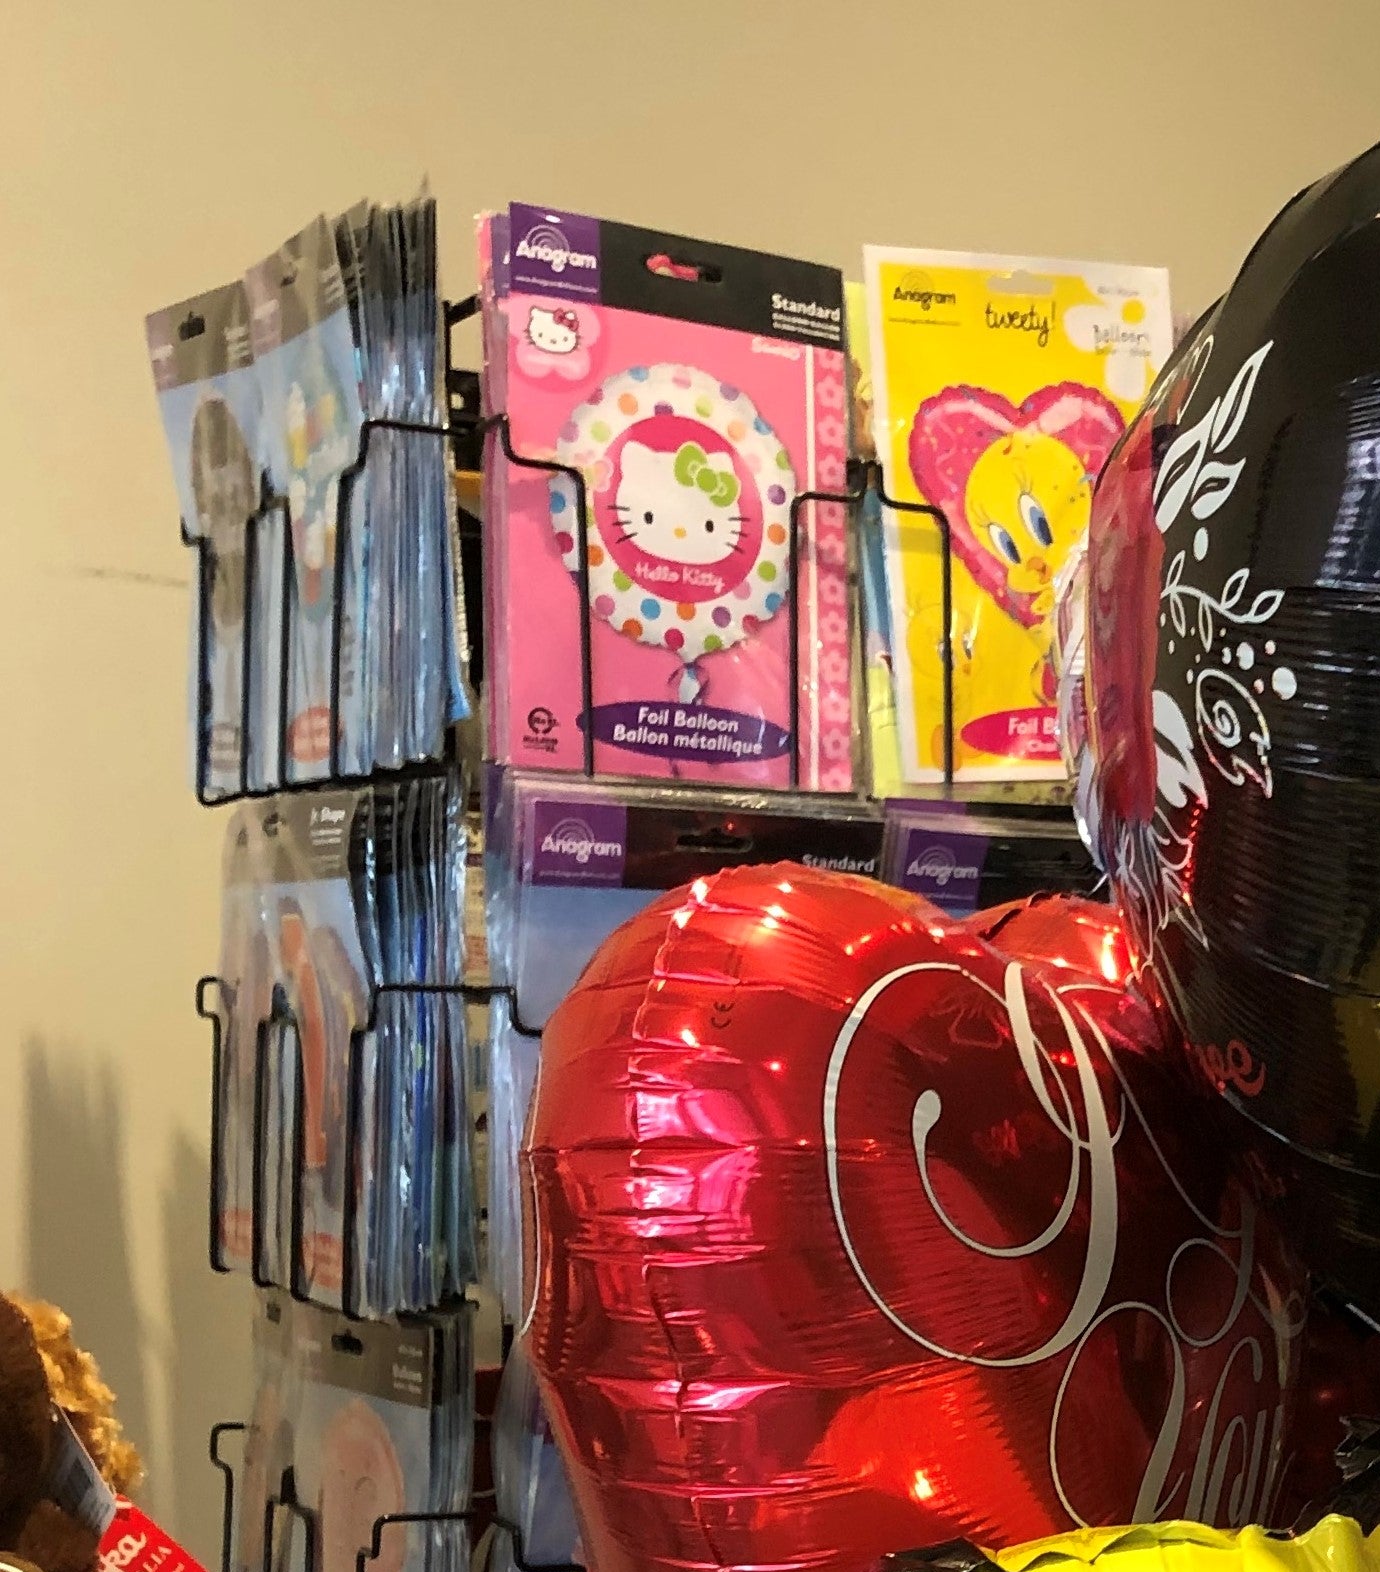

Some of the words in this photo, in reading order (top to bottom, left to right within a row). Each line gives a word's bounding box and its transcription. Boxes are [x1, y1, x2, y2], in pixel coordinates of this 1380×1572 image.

[771, 293, 841, 323] Standard
[634, 562, 680, 584] Hello
[637, 706, 670, 727] Foil
[673, 708, 739, 733] Balloon
[1007, 716, 1039, 735] Foil
[612, 725, 669, 747] Ballon
[540, 835, 623, 864] Anagram
[906, 859, 980, 886] Anagram
